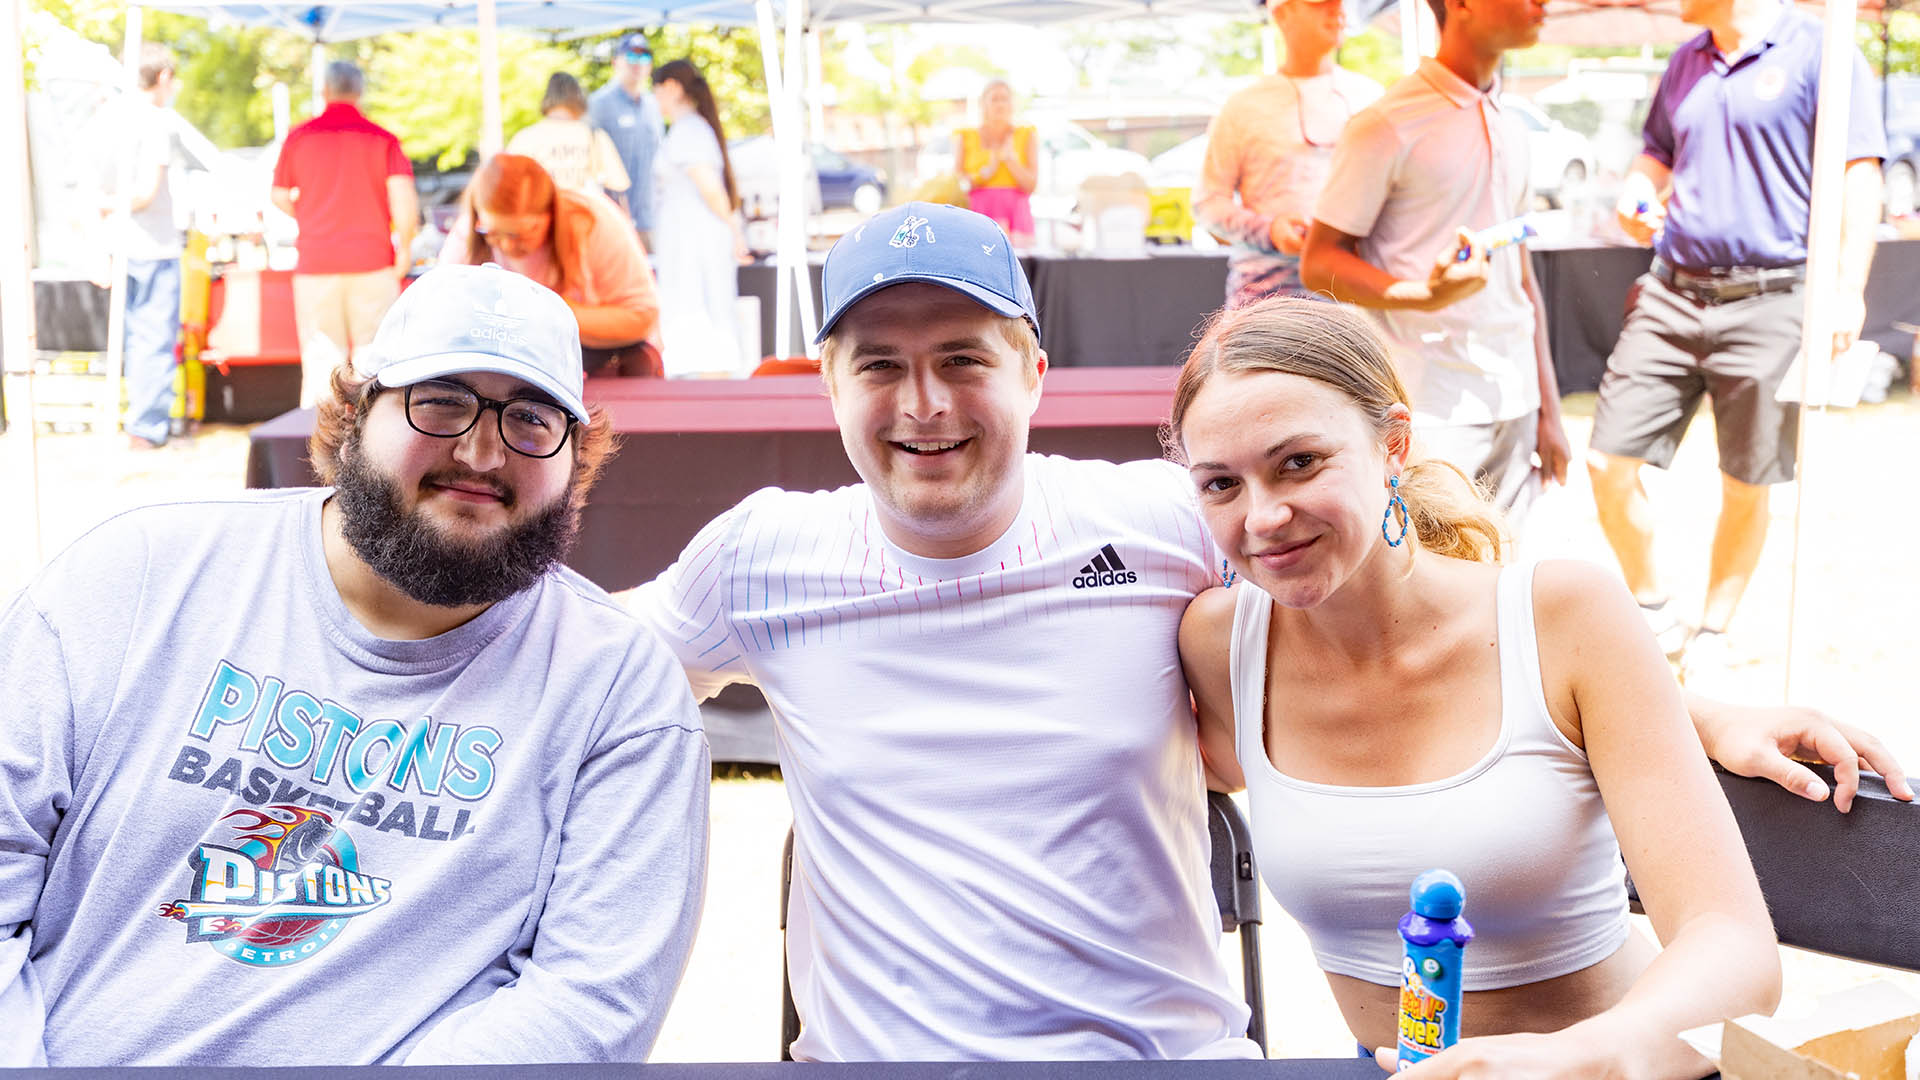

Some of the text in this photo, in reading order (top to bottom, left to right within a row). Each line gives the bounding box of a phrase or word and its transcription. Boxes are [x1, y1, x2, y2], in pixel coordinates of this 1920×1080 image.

[471, 327, 528, 345] adidas
[1072, 570, 1137, 589] adidas
[188, 659, 503, 802] PISTONS
